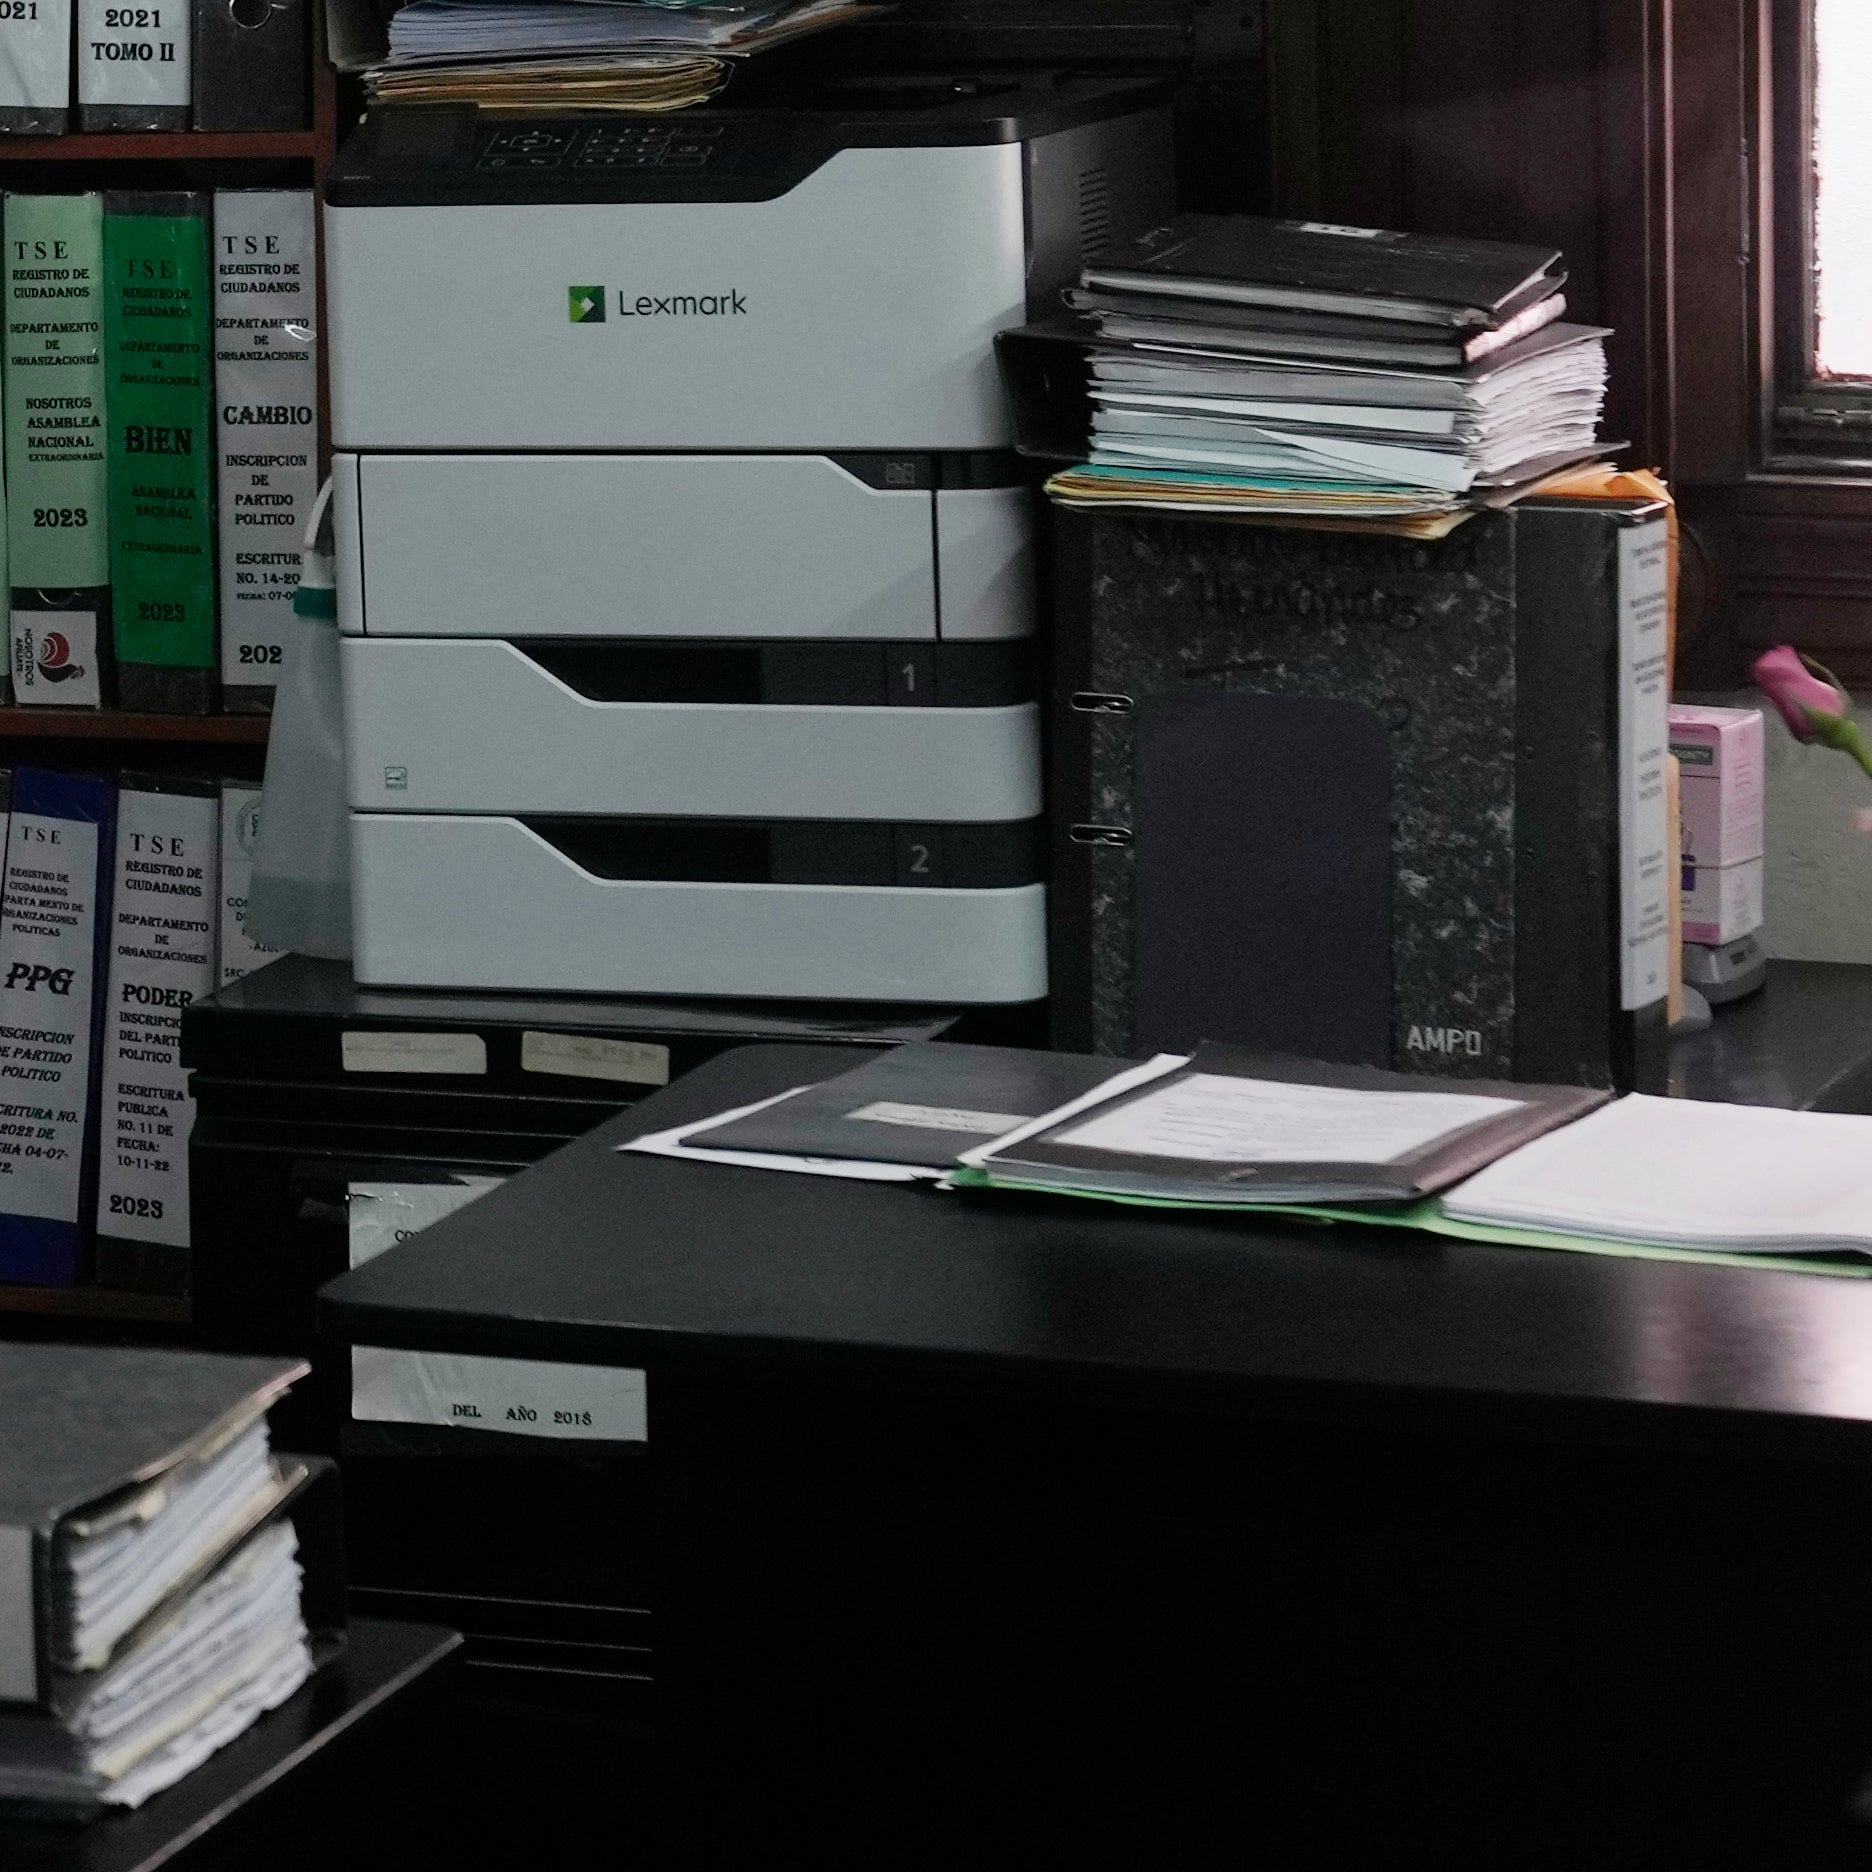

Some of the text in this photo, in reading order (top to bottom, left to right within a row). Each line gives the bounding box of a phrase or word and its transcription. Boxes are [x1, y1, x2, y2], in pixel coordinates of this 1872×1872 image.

[91, 43, 176, 61] TOMO II
[619, 290, 747, 317] Lexmark
[26, 396, 92, 410] NOSOTROS
[222, 406, 313, 426] CAMBIO
[225, 454, 308, 468] INSCRIPCION
[33, 508, 88, 528] 2023
[234, 513, 295, 526] POLITICO
[902, 662, 915, 692] 1
[910, 844, 930, 874] 2
[3, 962, 75, 996] PPG
[122, 982, 194, 1007] PODER
[1406, 1027, 1483, 1057] AMPO
[109, 1193, 164, 1220] 2023
[452, 1403, 482, 1418] DEL
[506, 1405, 537, 1422] AÑO
